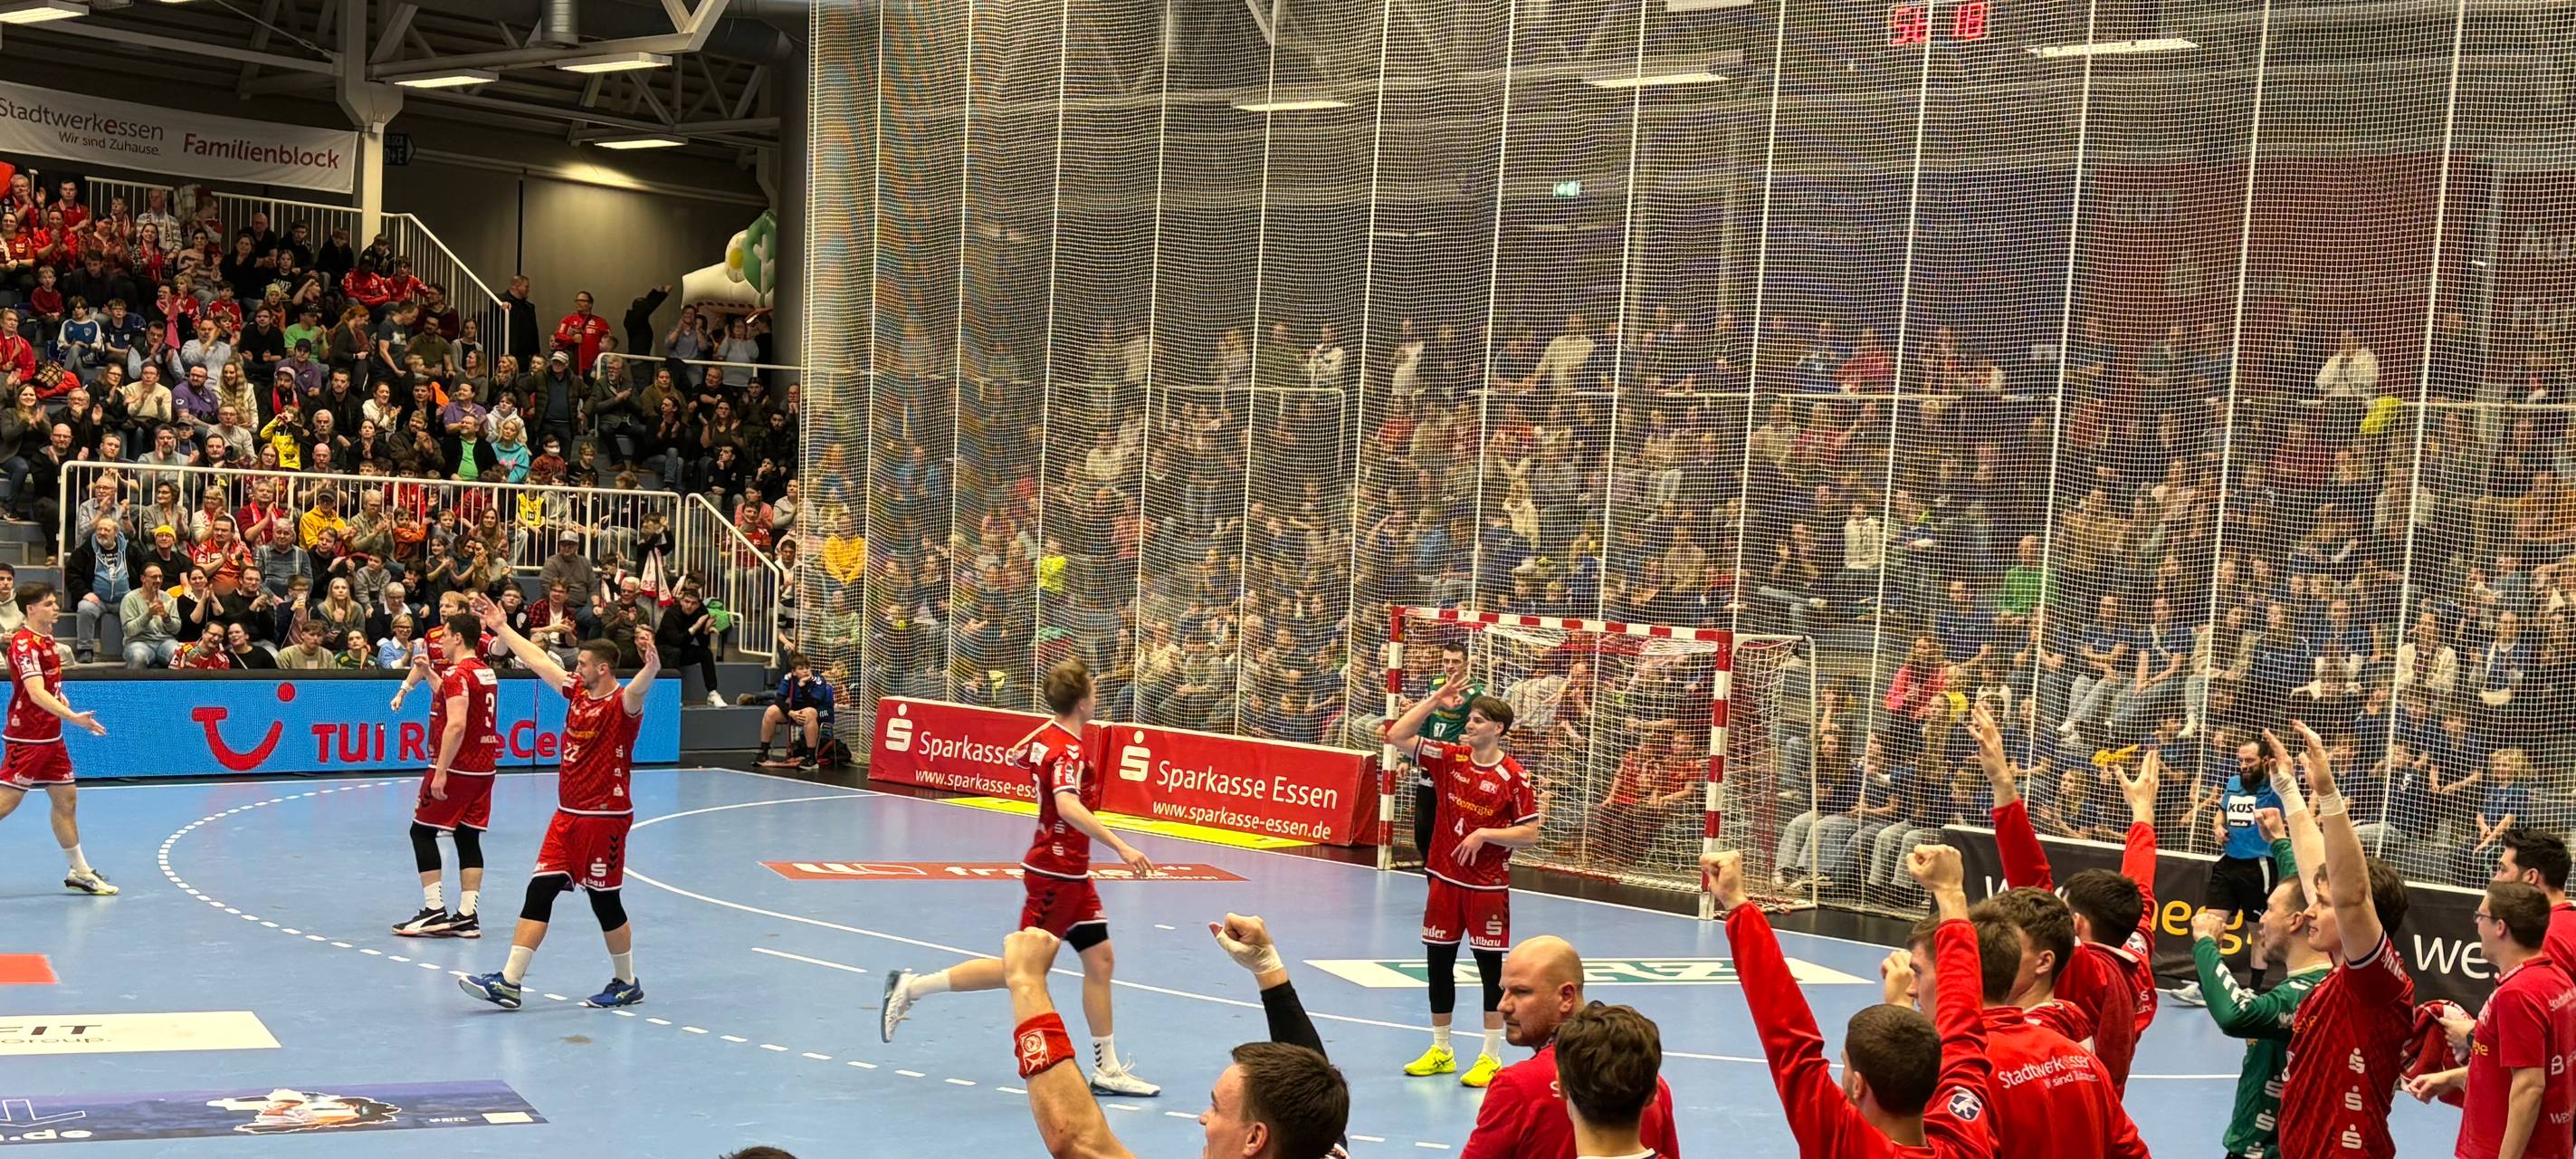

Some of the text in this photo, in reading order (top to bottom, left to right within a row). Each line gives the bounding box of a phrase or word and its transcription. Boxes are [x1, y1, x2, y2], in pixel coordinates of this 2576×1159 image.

[58, 130, 161, 157] Wir sind Zuhause.
[183, 133, 340, 169] Familienblock
[485, 692, 495, 728] 3
[311, 723, 386, 762] TUI
[919, 731, 1017, 767] Sparkasse
[914, 770, 1038, 799] www.sparkasse-ess
[1156, 760, 1338, 809] Sparkasse Essen
[1152, 800, 1331, 840] www.sparkasse-essen.de
[1454, 817, 1465, 837] 4
[2413, 934, 2490, 980] we
